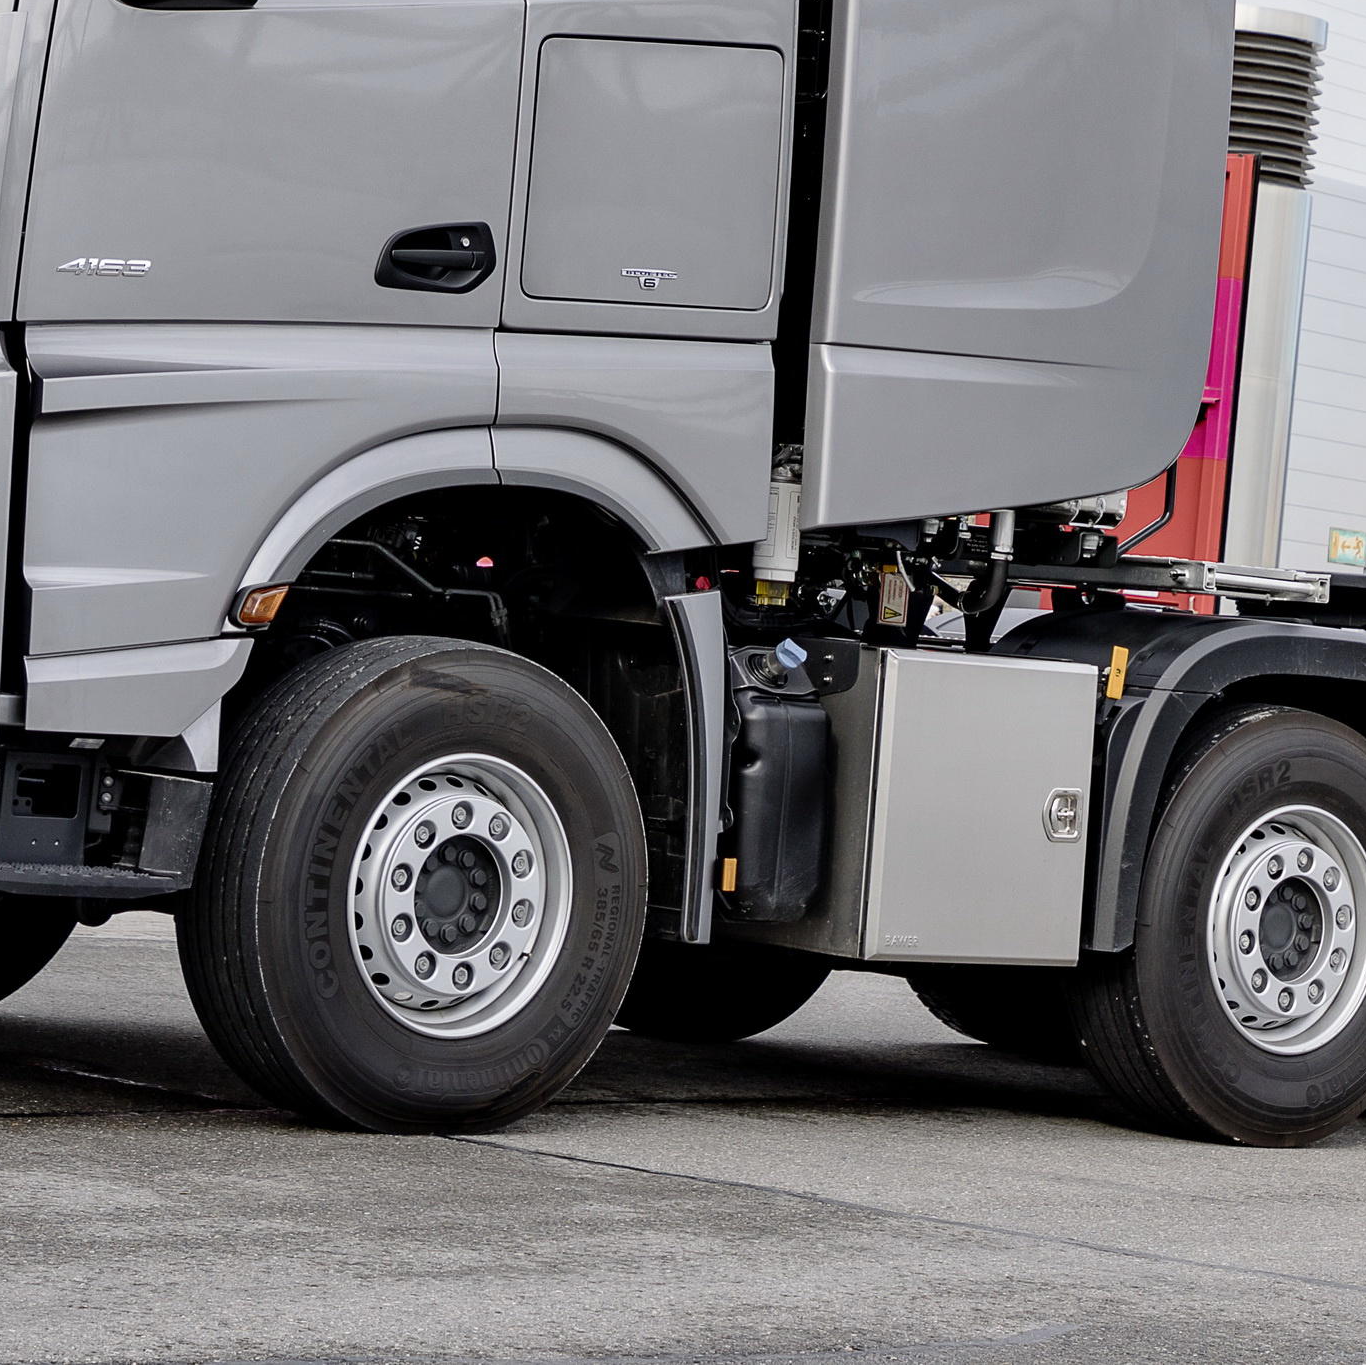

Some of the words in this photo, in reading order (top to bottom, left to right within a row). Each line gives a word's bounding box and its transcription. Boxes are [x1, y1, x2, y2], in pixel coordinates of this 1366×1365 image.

[643, 278, 656, 288] 6
[303, 721, 415, 999] CONTINENTAL
[588, 887, 609, 953] 385/65
[581, 956, 595, 971] R
[560, 973, 587, 1013] 22.5
